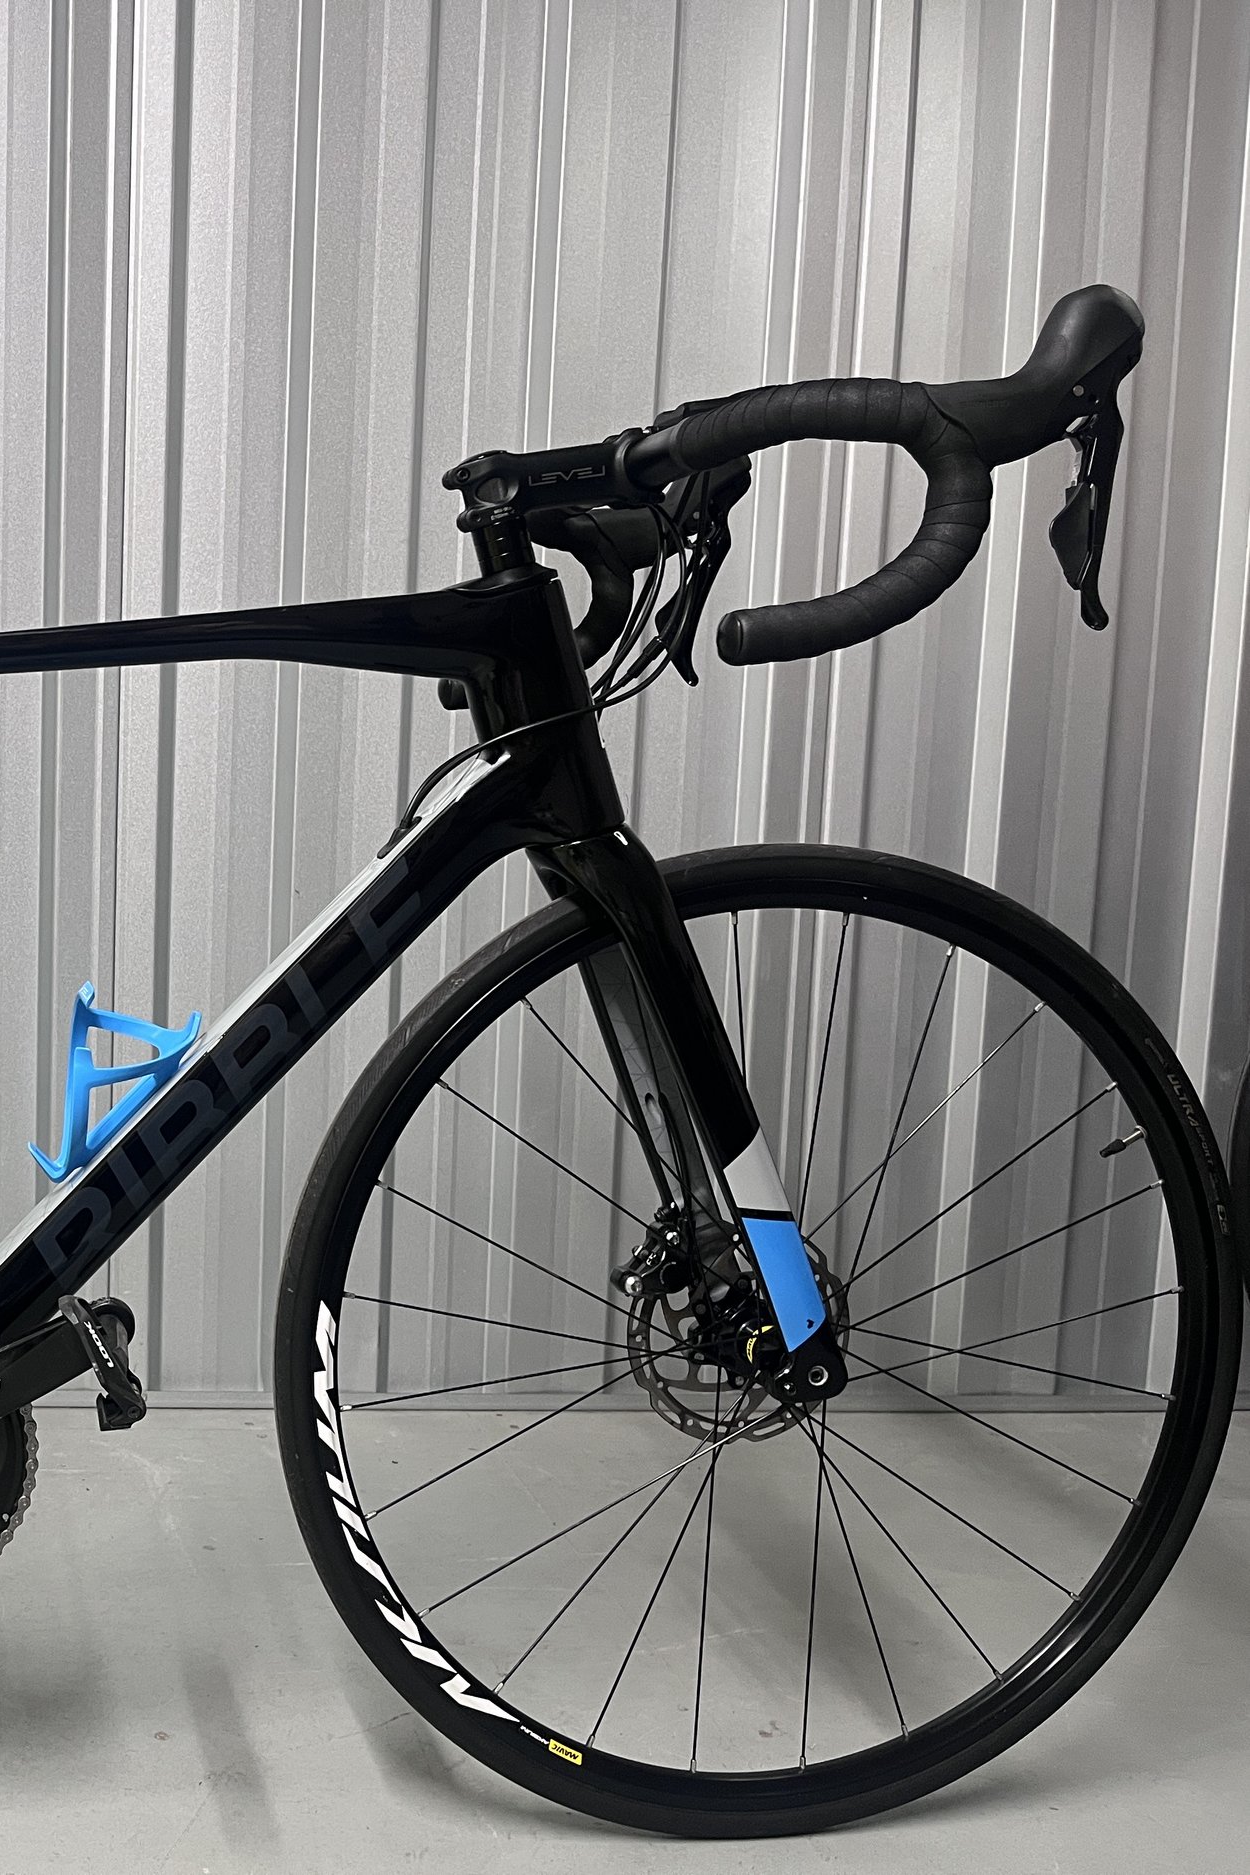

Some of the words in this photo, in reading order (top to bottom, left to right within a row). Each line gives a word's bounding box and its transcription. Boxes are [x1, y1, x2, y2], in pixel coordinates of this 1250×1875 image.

[528, 464, 607, 487] LEVEL
[33, 856, 423, 1290] RIBBLE
[83, 1319, 115, 1369] LOOK
[550, 1742, 580, 1761] MAVIC
